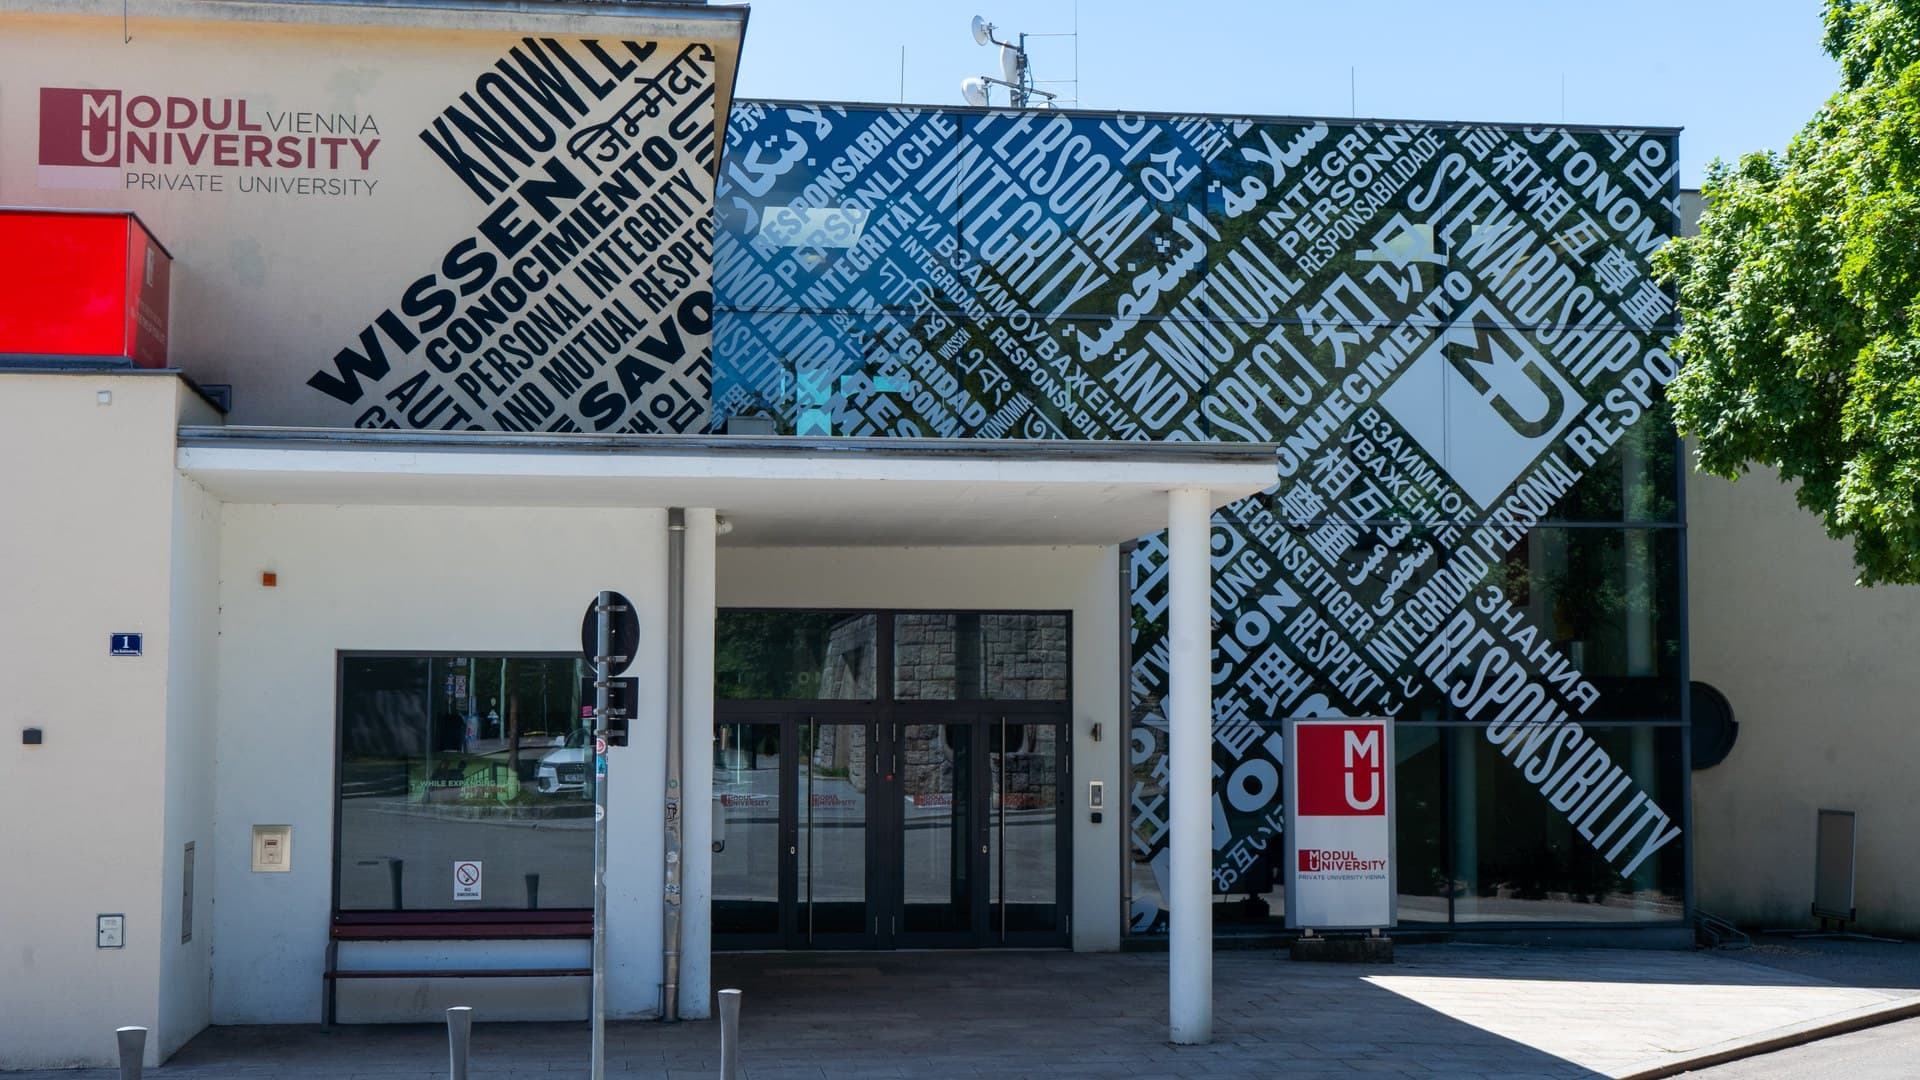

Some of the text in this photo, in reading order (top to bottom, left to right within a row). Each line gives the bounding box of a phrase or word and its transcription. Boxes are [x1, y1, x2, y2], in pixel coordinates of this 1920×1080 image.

[126, 173, 379, 196] PRIVATE UNIVERSITY
[266, 111, 380, 135] VIENNA
[426, 136, 678, 374] CONOCIMIENTO
[775, 109, 958, 289] PERSÖNLICHE
[800, 191, 924, 318] INTEGRITÄT
[914, 133, 1110, 326] INTEGRITY
[1296, 127, 1446, 279] RESPONSABILIDADE
[307, 156, 586, 405] WISSEN
[455, 283, 591, 410] PERSONAL
[573, 167, 707, 301] INTEGRITY
[900, 235, 995, 331] INTEGRIDADE
[1102, 236, 1306, 431] AND MUTUAL
[1407, 152, 1641, 388] STEWARDSHIP
[386, 370, 486, 431] AUT
[491, 382, 556, 431] AND
[539, 298, 648, 400] MUTUAL
[848, 288, 987, 428] INTEGRIDAD
[938, 328, 972, 361] WISSEN
[1309, 446, 1395, 534] 相互
[1341, 424, 1462, 550] УВАЖЕНИЕ
[1357, 407, 1477, 530] ВЗАИМНОЕ
[1365, 544, 1489, 674] INTEGRIDAD
[1472, 452, 1583, 562] PERSONAL
[122, 635, 130, 649] 1
[1284, 605, 1385, 708] RESPEKT
[1475, 585, 1601, 715] ЗНАНИЯ
[1414, 607, 1683, 880] RESPONSIBILITY
